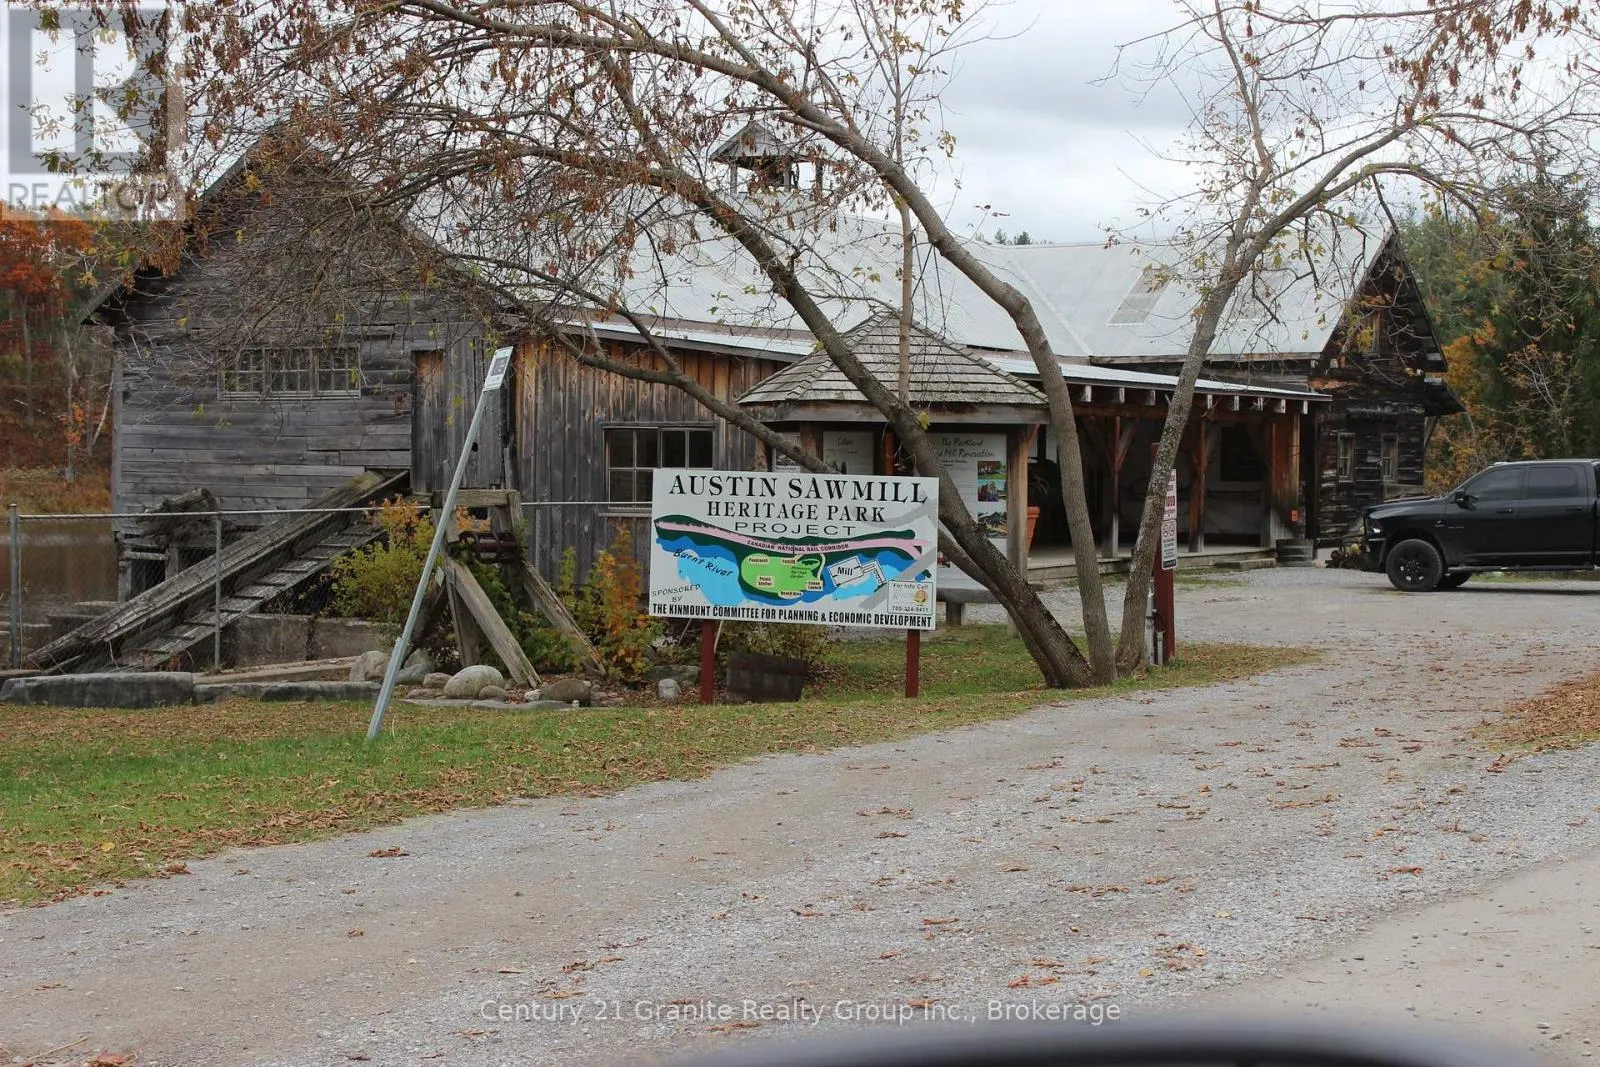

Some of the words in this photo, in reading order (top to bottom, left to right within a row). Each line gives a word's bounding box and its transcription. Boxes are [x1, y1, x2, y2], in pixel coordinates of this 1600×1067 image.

[669, 475, 777, 497] AUSTIN
[788, 477, 928, 503] SAWMILL
[707, 501, 818, 520] HERITAGE
[828, 505, 885, 522] PARK
[735, 522, 856, 536] PROJECT
[747, 540, 775, 553] CANADIAN
[777, 544, 806, 552] NATIONAL
[807, 544, 819, 552] RAIL
[821, 543, 849, 552] CORRIDOR
[673, 549, 704, 564] Burnt
[705, 561, 734, 576] River
[837, 566, 853, 576] Mill
[651, 583, 701, 597] SPONSORED
[653, 603, 667, 614] THE
[669, 604, 710, 616] KINMOUNT
[713, 606, 759, 618] COMMITTEE
[761, 608, 776, 619] FOR
[778, 609, 819, 621] PLANNING
[821, 612, 827, 621] &
[829, 611, 872, 624] ECONOMIC
[874, 614, 932, 628] DEVELOPMENT
